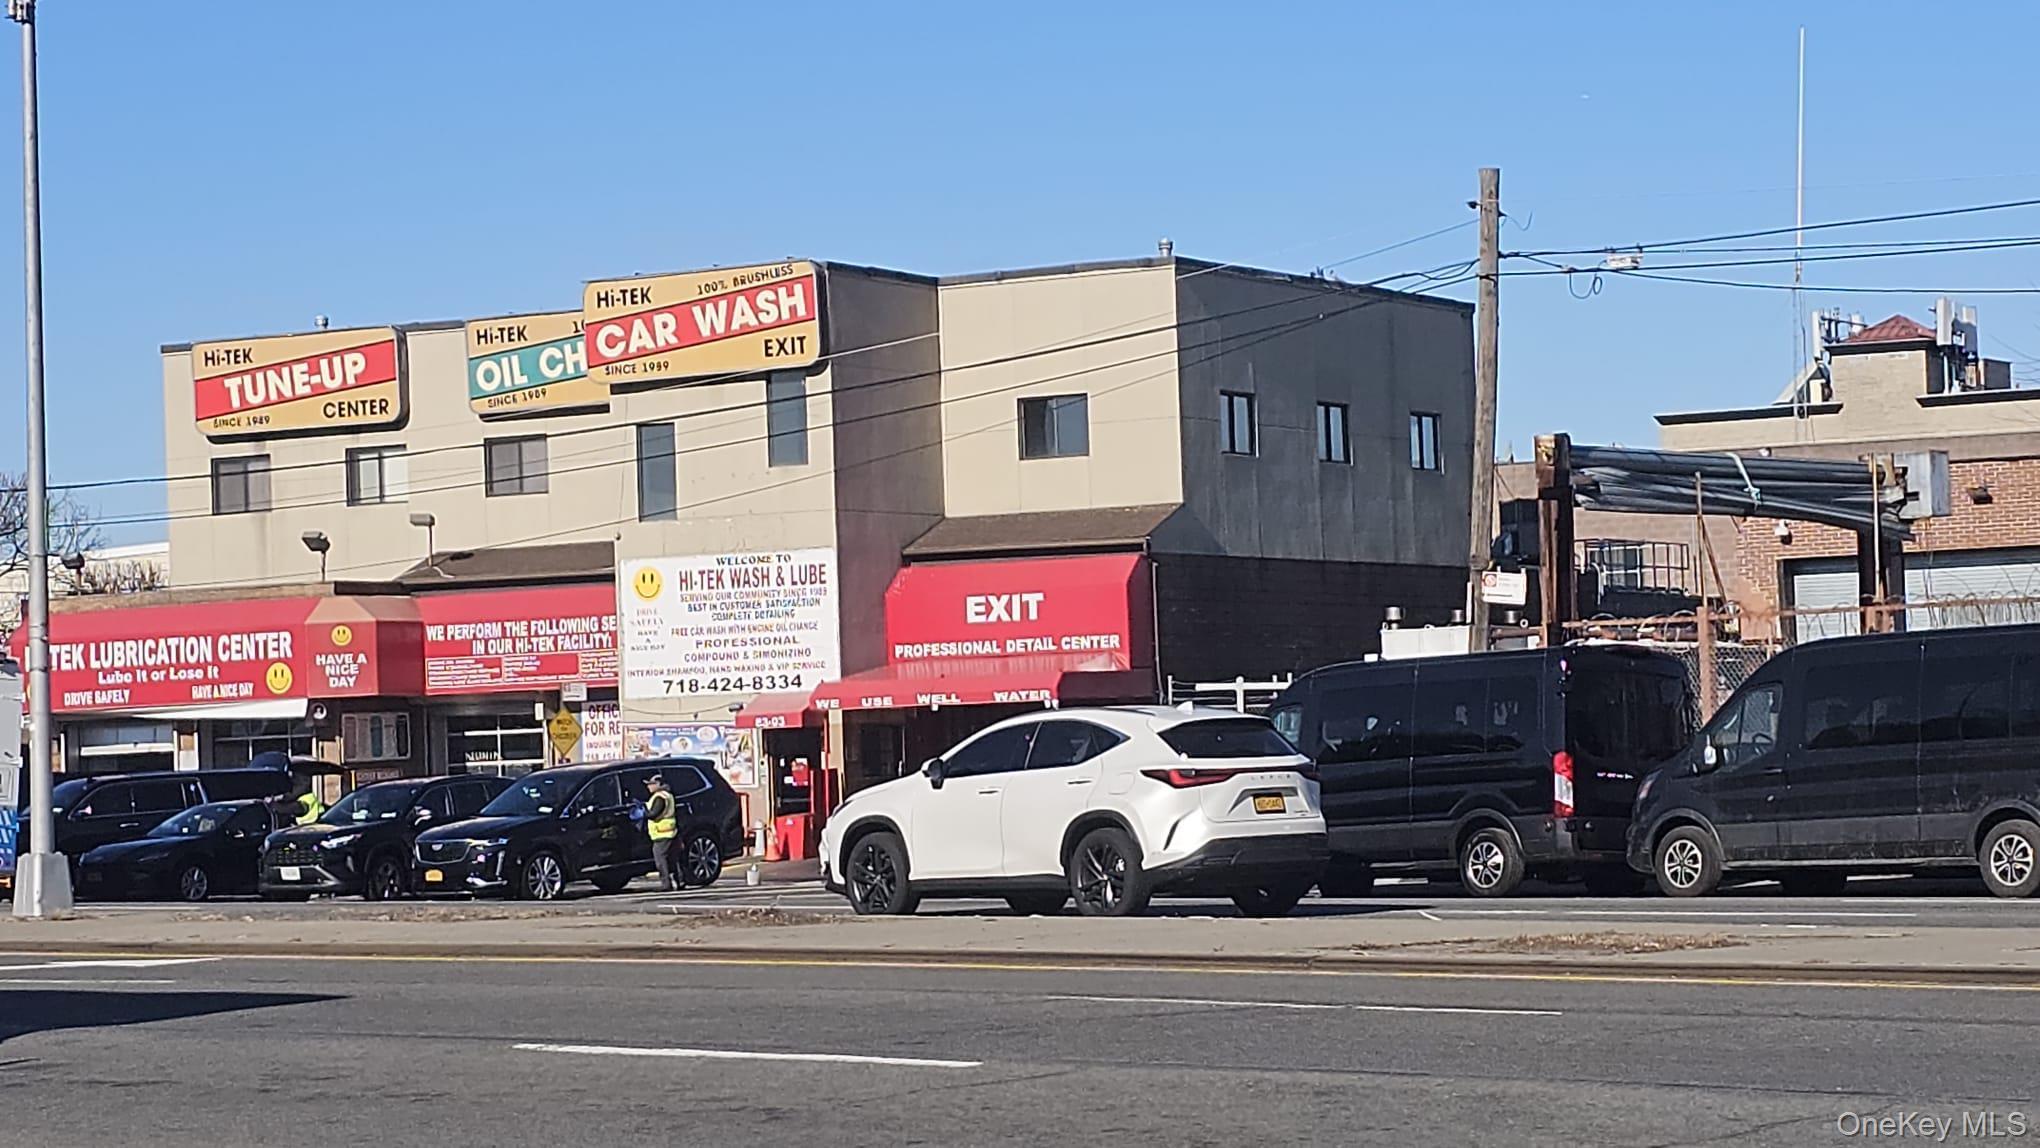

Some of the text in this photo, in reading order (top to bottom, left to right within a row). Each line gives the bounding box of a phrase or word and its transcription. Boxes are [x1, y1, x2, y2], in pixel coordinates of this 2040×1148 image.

[698, 264, 794, 295] 100% BRUSHLESS
[597, 286, 652, 308] Hi-TEK
[596, 282, 807, 358] CAR WASH
[476, 325, 528, 345] Hi-TEK
[764, 336, 806, 357] EXIT
[204, 348, 253, 366] Hi-TEK
[476, 355, 528, 391] OIL
[605, 364, 637, 375] SINCE
[224, 352, 366, 409] TUNE-UP
[323, 398, 389, 418] CENTER
[487, 394, 518, 408] SINCE
[213, 417, 242, 428] SINCE
[716, 554, 791, 566] WELCOME TO
[679, 564, 827, 591] HI-TEK WASH & LUBE
[680, 592, 713, 602] SERVING
[715, 592, 731, 601] OUR
[734, 589, 780, 600] COMMUNITY
[688, 598, 820, 612] BEST IN CUSTOMER SATISFACTION
[966, 593, 1043, 623] EXIT
[712, 609, 796, 621] COMPLETE DETAILING
[426, 625, 445, 641] WE
[447, 622, 501, 640] PERFORM
[504, 621, 529, 637] THE
[531, 616, 598, 636] FOLLOWING
[671, 621, 818, 637] FREE CAR WASH WITH ENGINE OIL CHANGE
[90, 636, 212, 669] LUBRICATION
[217, 631, 293, 661] CENTER
[472, 640, 485, 655] IN
[487, 638, 513, 654] OUR
[515, 636, 556, 653] HI-TEK
[695, 635, 800, 648] PROFESSIONAL
[895, 634, 1120, 658] PROFESSIONAL DETAIL CENTER
[316, 653, 367, 666] HAVE A
[684, 651, 739, 662] COMPOUND
[98, 671, 132, 685] Lube
[150, 670, 166, 682] or
[169, 666, 204, 680] Lose
[325, 663, 359, 676] NICE
[239, 682, 254, 697] DAY
[329, 676, 356, 688] DAY
[663, 674, 802, 694] 718-424-8334
[64, 689, 131, 706] DRIVE SAFELY
[815, 690, 1052, 710] WE USE WELL WATER
[585, 721, 605, 736] FOR
